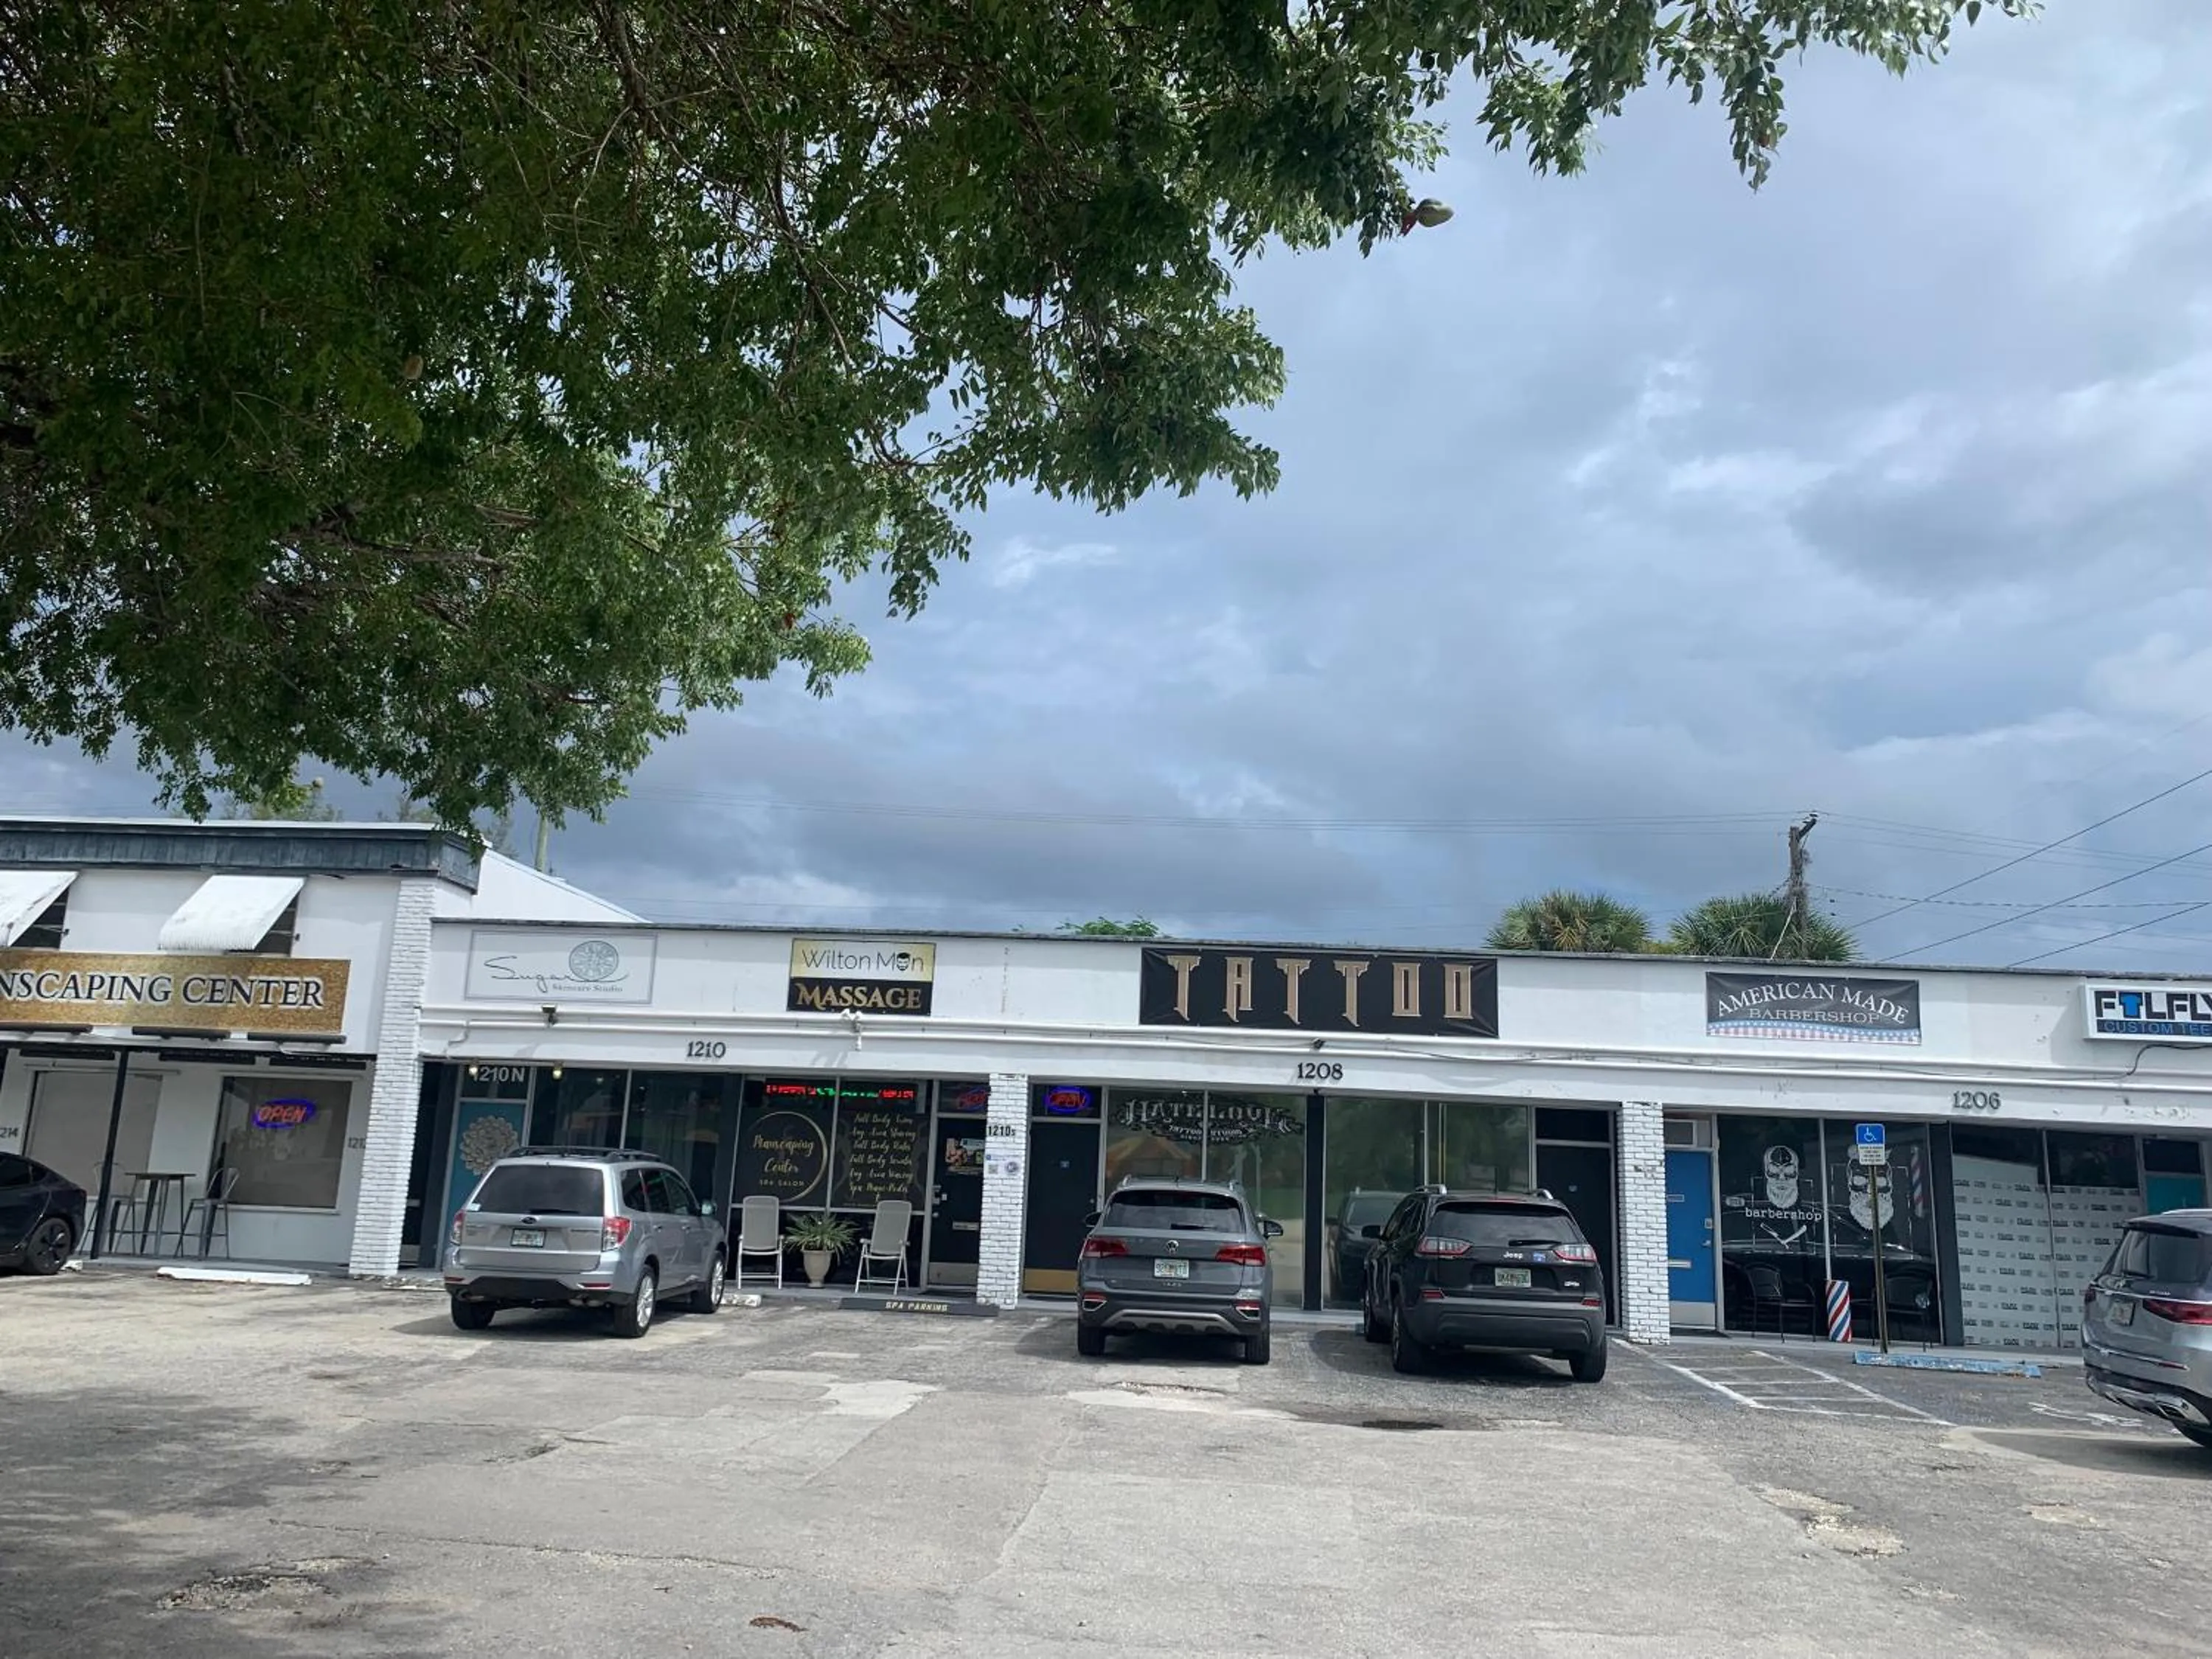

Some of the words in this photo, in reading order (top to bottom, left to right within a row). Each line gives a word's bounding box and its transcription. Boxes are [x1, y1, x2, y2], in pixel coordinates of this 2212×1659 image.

[801, 948, 871, 971] Wilton
[484, 955, 629, 993] Sugar
[0, 973, 172, 1003] NSCAPING
[182, 977, 324, 1007] CENTER
[796, 982, 922, 1010] MASSAGE
[1167, 955, 1474, 1027] TATTOO
[1717, 982, 1837, 1017] AMERICAN
[1840, 987, 1910, 1025] MADE
[1749, 1008, 1881, 1024] BARBERSHOP
[2104, 1020, 2174, 1034] CUSTOM
[2181, 1023, 2212, 1035] TEE
[686, 1040, 726, 1059] 1210
[1296, 1062, 1344, 1081] 1208
[1952, 1091, 2002, 1110] 1206
[258, 1106, 307, 1123] OPEN
[1745, 1207, 1823, 1223] barbershop
[885, 1301, 904, 1310] SPA
[908, 1302, 948, 1312] PARKING
